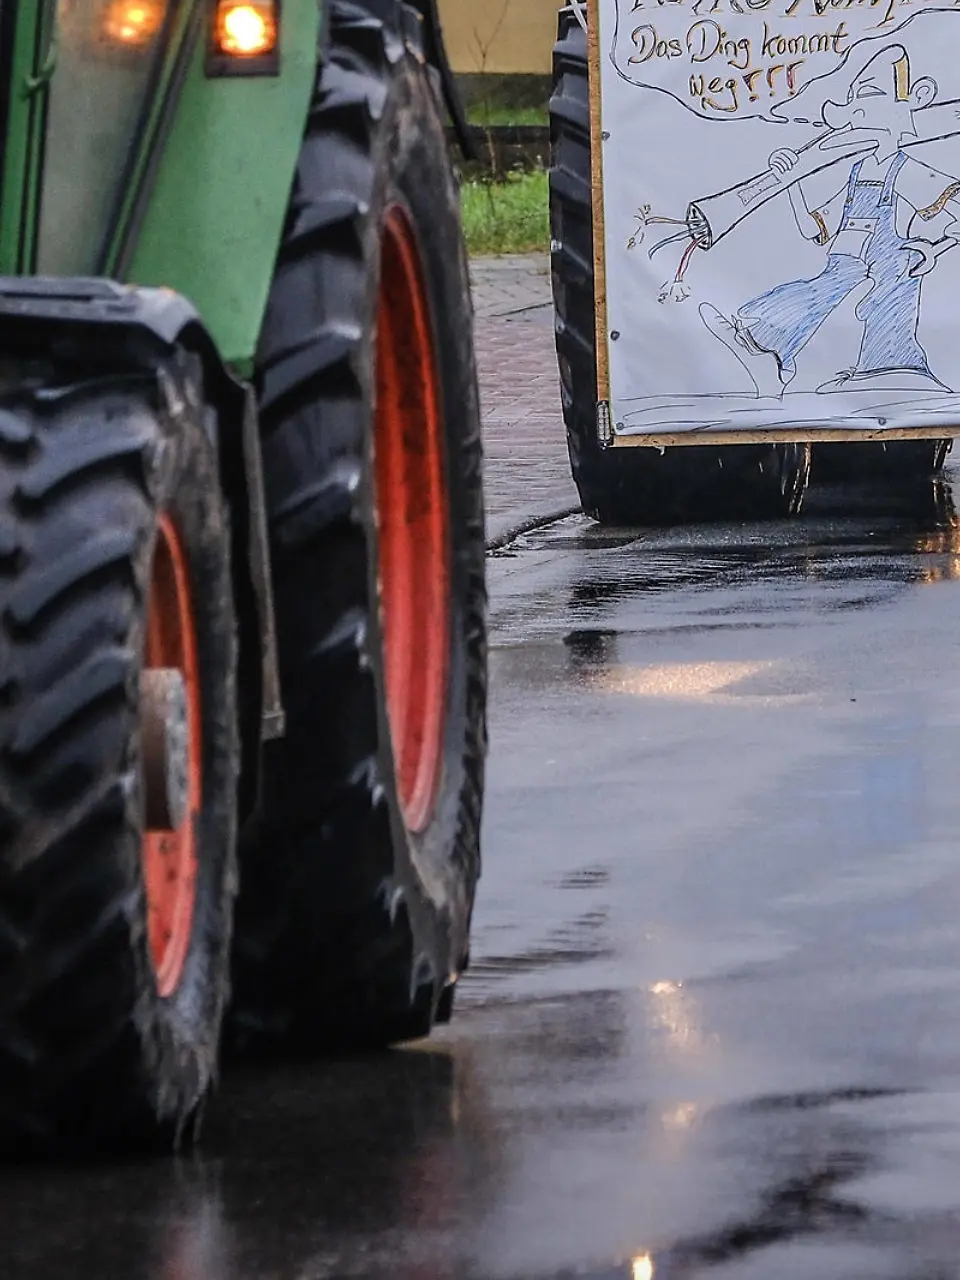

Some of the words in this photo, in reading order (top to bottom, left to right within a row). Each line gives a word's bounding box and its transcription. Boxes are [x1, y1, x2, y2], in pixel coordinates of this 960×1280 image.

[628, 22, 683, 66] Das
[686, 19, 750, 69] Ding
[760, 21, 850, 59] kommt
